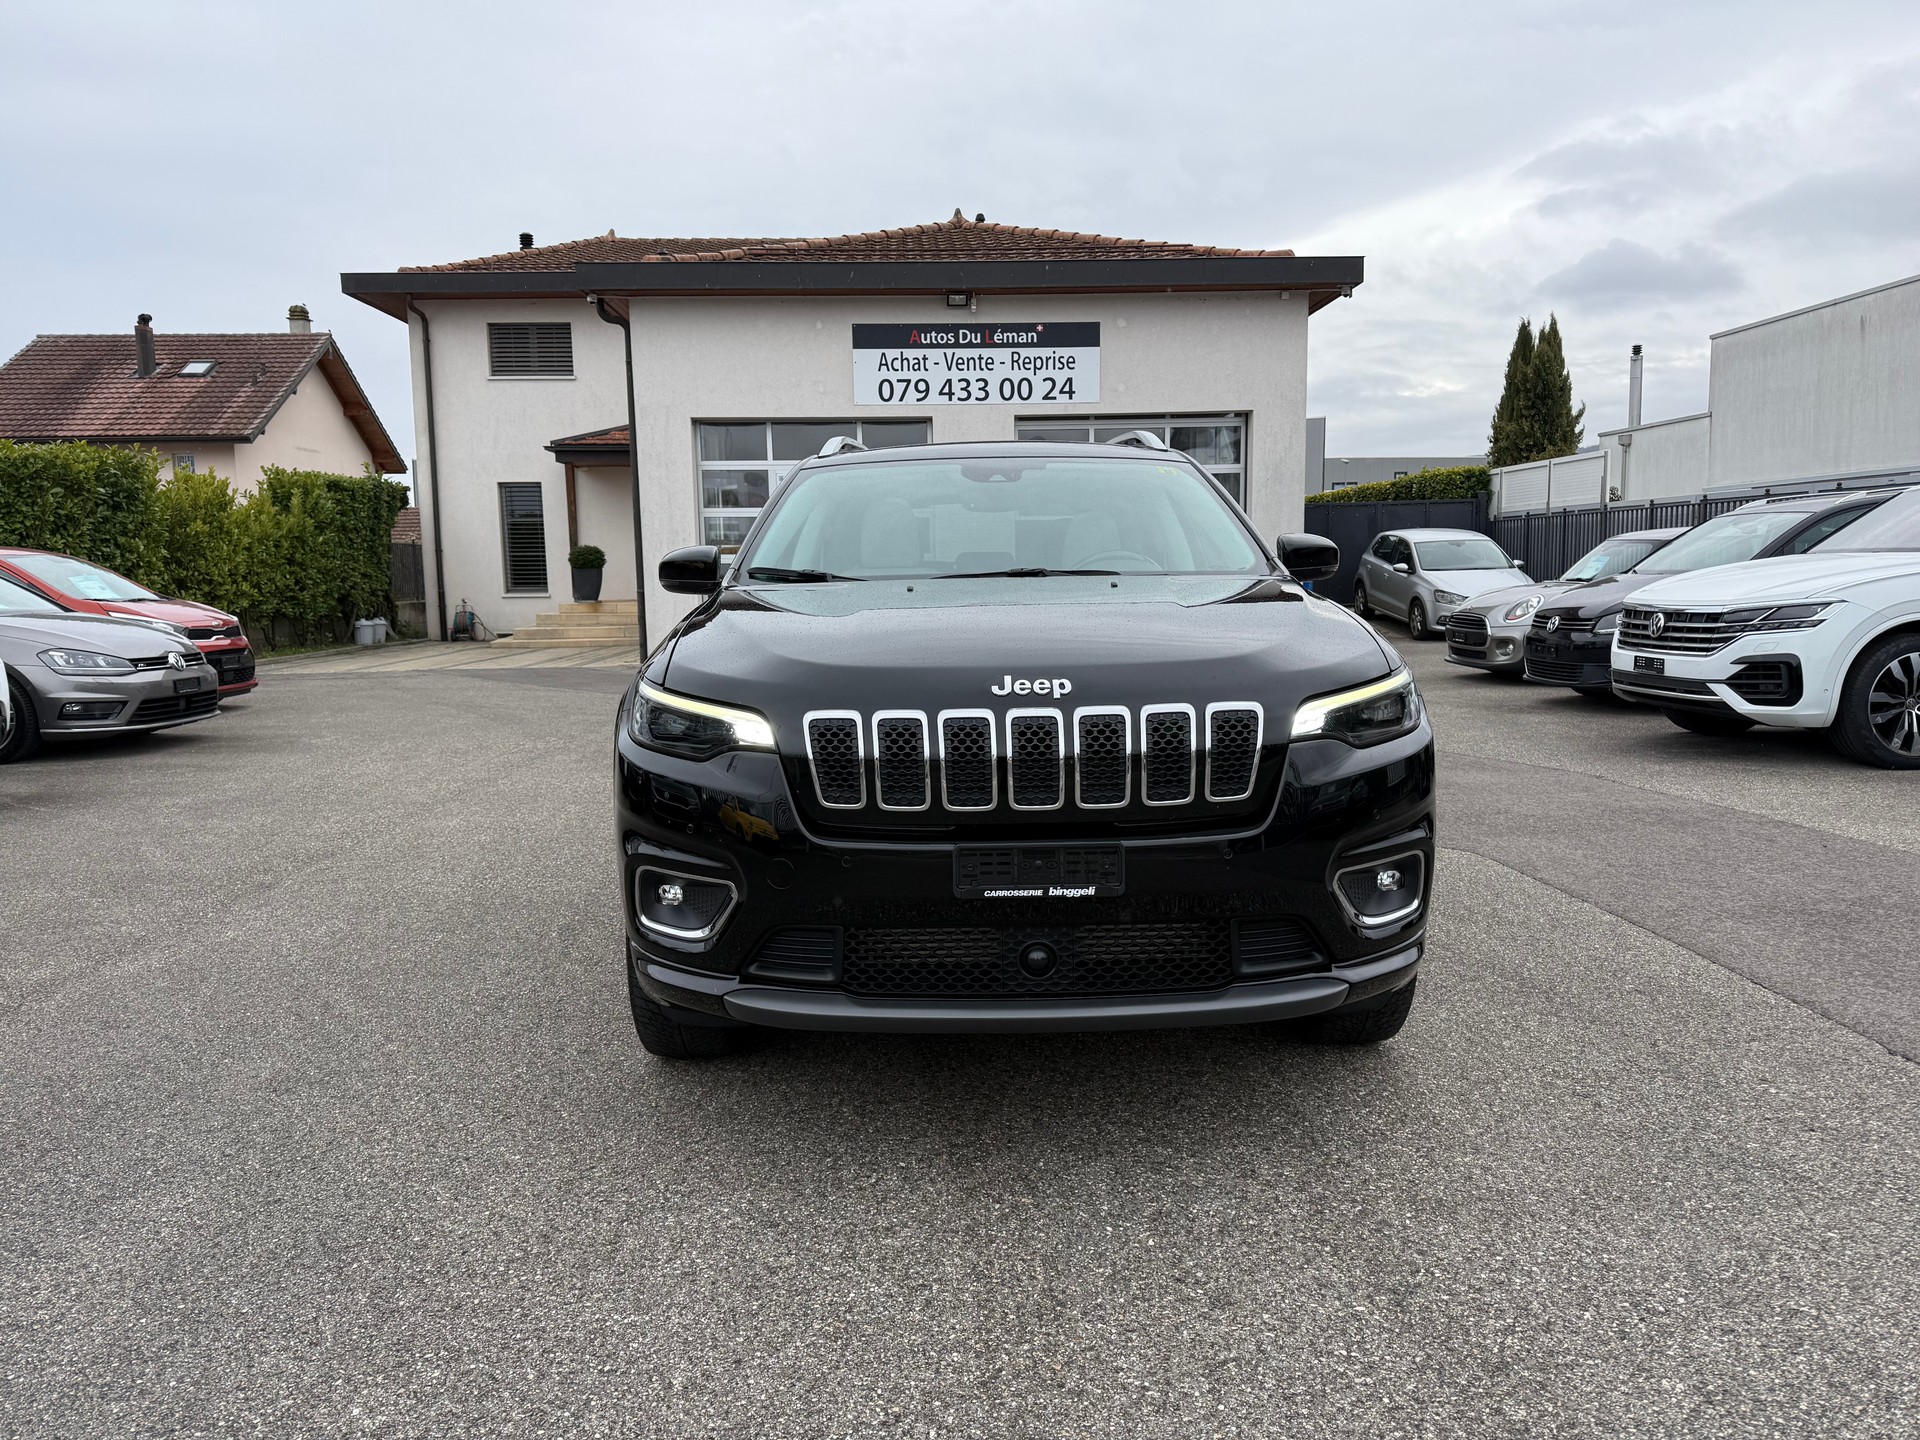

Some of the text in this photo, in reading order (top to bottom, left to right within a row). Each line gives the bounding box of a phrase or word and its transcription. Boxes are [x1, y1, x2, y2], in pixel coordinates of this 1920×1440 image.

[910, 328, 1038, 344] Autos Du Léman
[877, 351, 929, 372] Achat
[943, 351, 995, 372] Vente
[1010, 350, 1076, 376] Reprise
[877, 376, 1076, 403] 079 433 00 24
[991, 675, 1072, 699] Jeep
[984, 886, 1096, 898] CARROSSERIE binggeli
